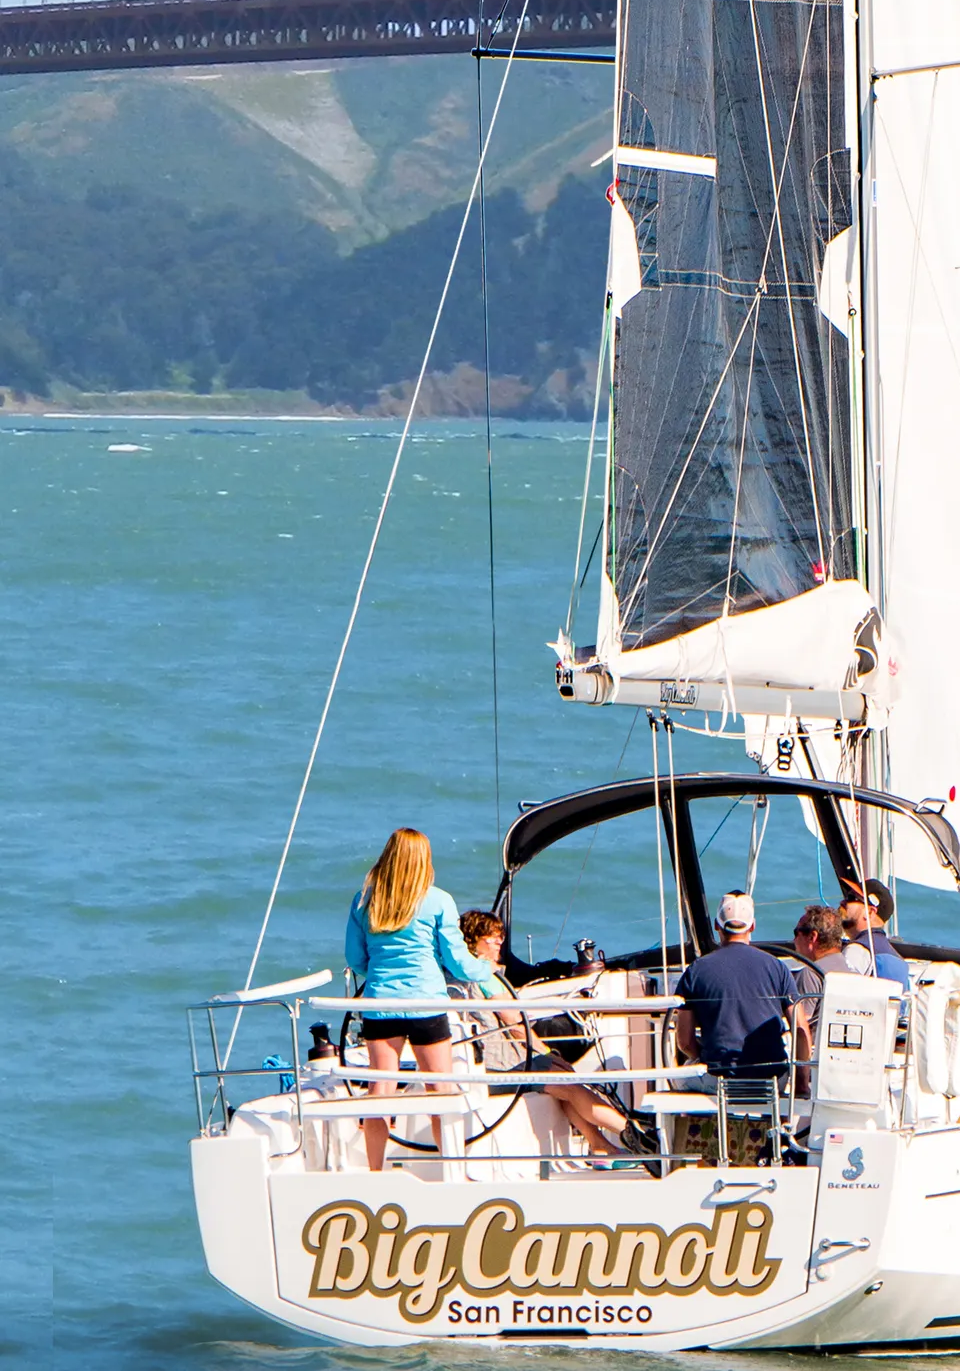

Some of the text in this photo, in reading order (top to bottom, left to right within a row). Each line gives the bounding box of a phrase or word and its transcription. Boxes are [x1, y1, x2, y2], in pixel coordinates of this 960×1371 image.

[305, 1204, 772, 1317] Big Cannoli
[448, 1300, 653, 1324] San Francisco
